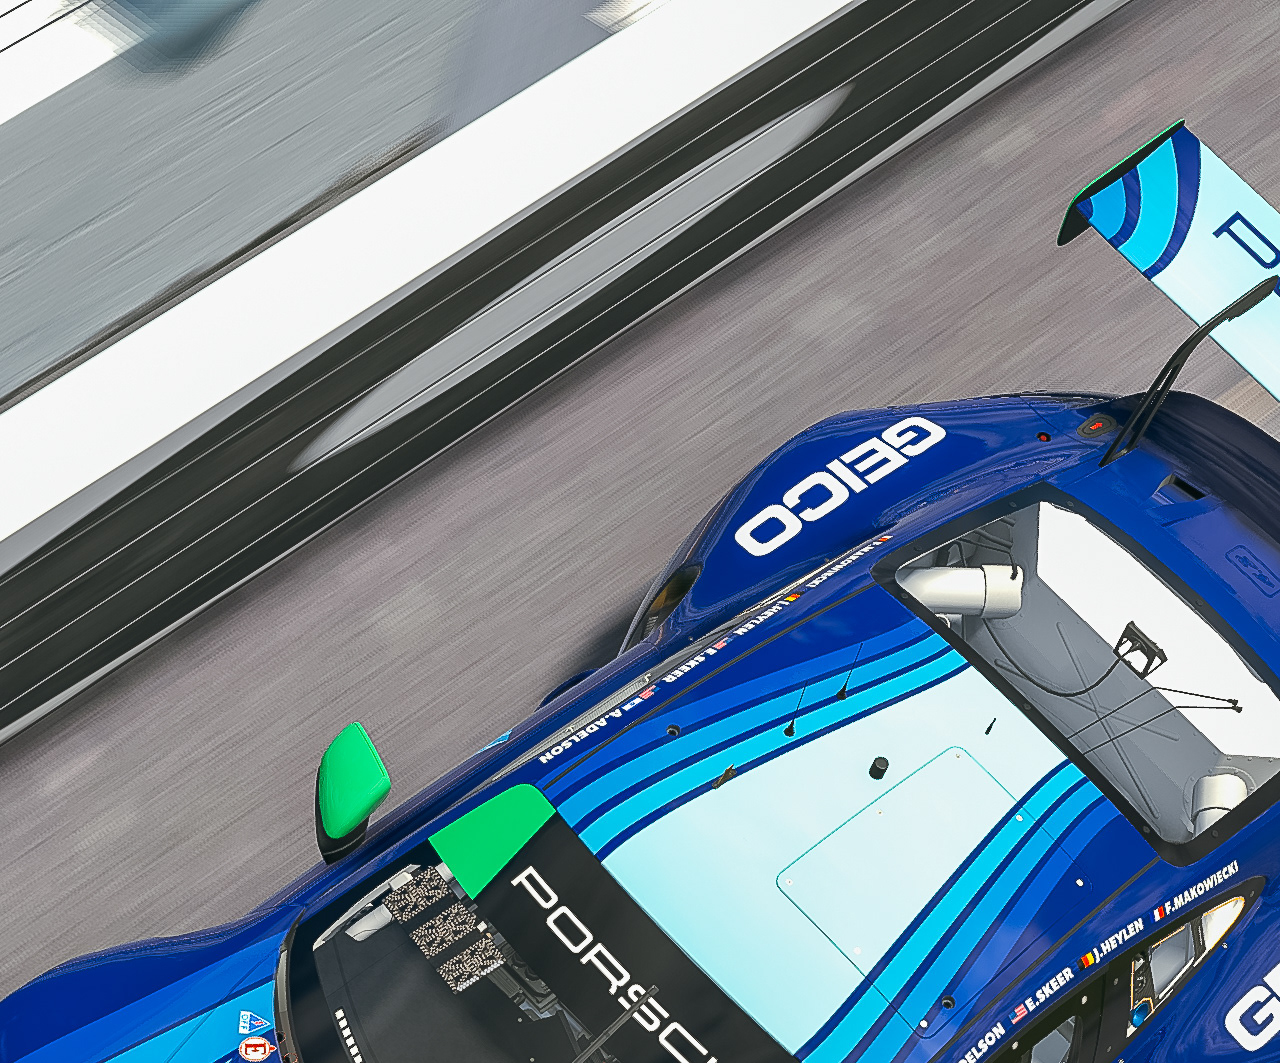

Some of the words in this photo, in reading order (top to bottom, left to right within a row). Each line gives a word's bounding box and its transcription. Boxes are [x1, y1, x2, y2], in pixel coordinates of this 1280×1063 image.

[735, 416, 946, 556] GEICO
[661, 647, 717, 682] E.SKEER
[538, 708, 622, 764] A.ADELSON
[1165, 860, 1239, 915] F.MAKOWIECKI
[1094, 917, 1144, 963] J.HEYLEN
[1024, 967, 1074, 1012] E.SKEER
